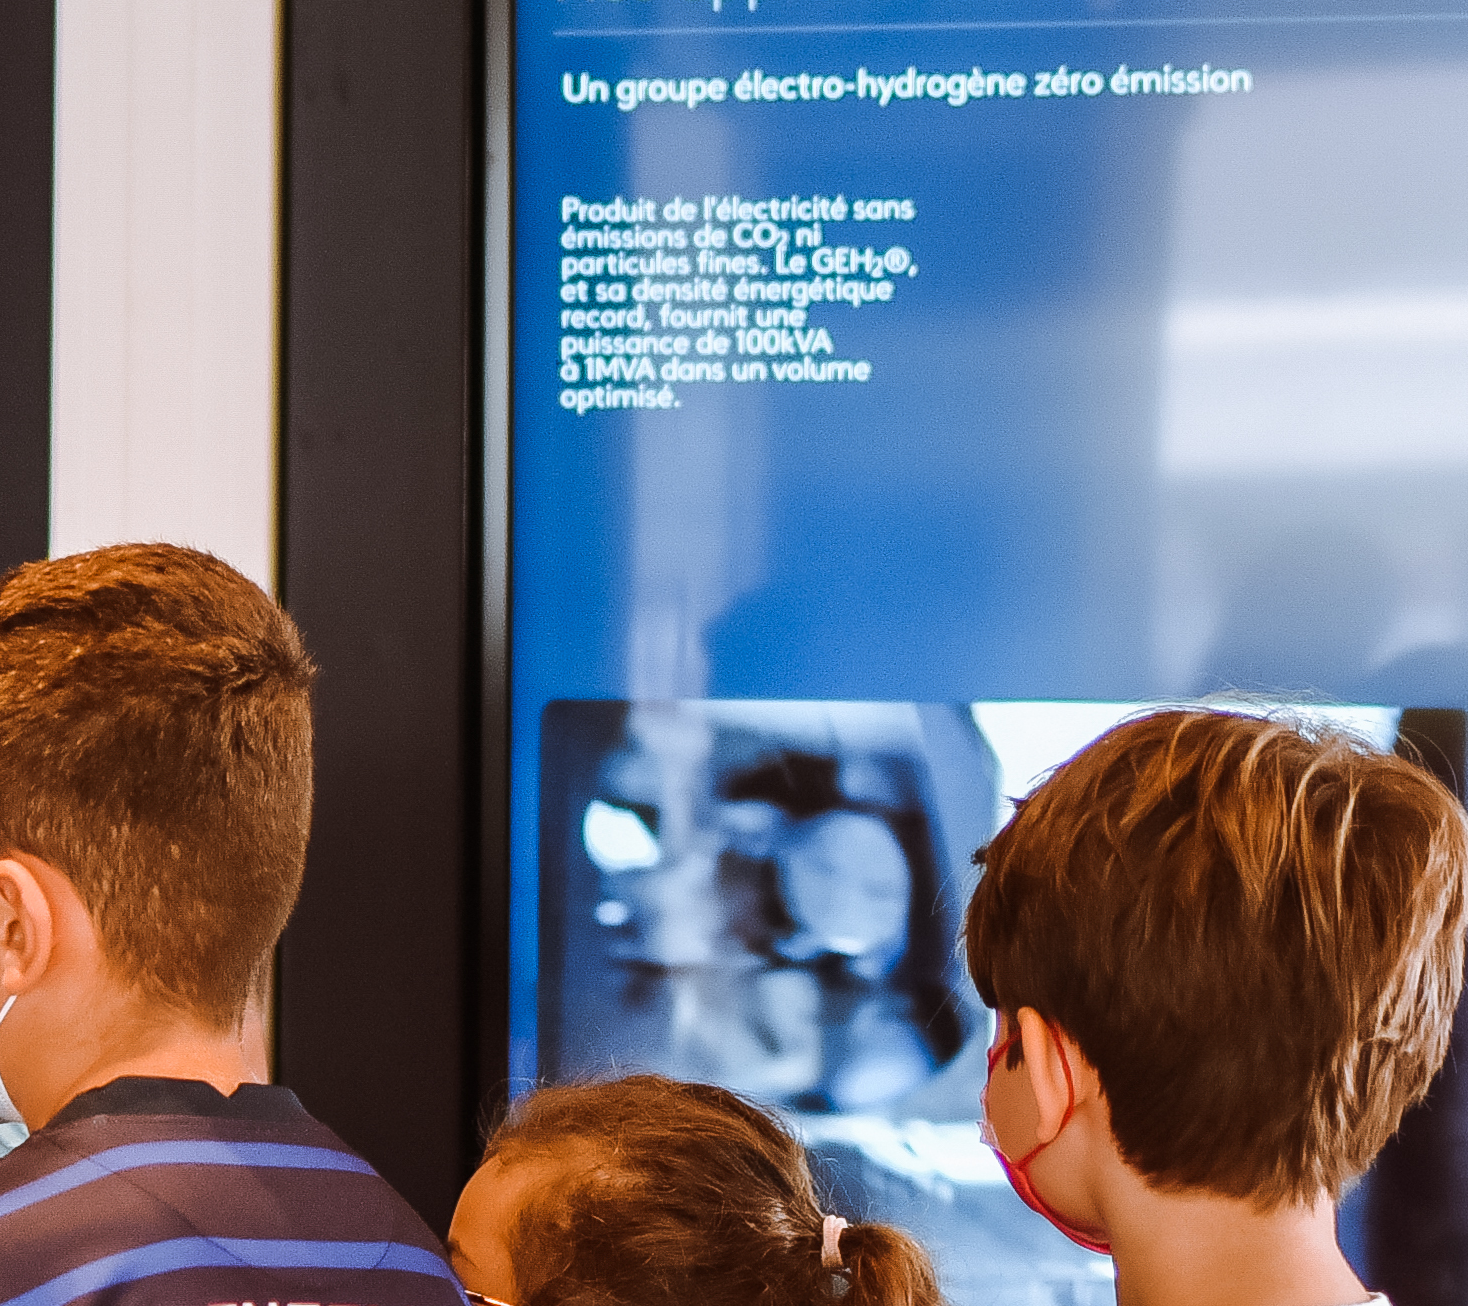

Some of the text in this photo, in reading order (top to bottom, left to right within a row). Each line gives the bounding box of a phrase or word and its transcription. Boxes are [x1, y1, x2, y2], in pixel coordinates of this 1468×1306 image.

[564, 64, 1252, 112] Un groupe électro-hydrogène zéro émission
[562, 195, 916, 223] Produit de l'électricité sans
[561, 225, 687, 250] émissions
[694, 223, 727, 249] de
[796, 222, 822, 247] ni
[562, 251, 690, 281] particules
[697, 250, 767, 276] fines.
[776, 248, 806, 275] Le
[561, 277, 894, 307] et sa densité énergétique
[561, 304, 808, 332] record, fournit une
[561, 328, 833, 361] puissance de 100kVA
[561, 357, 871, 382] à 1MVA dans un volume
[560, 384, 681, 415] optimisé.
